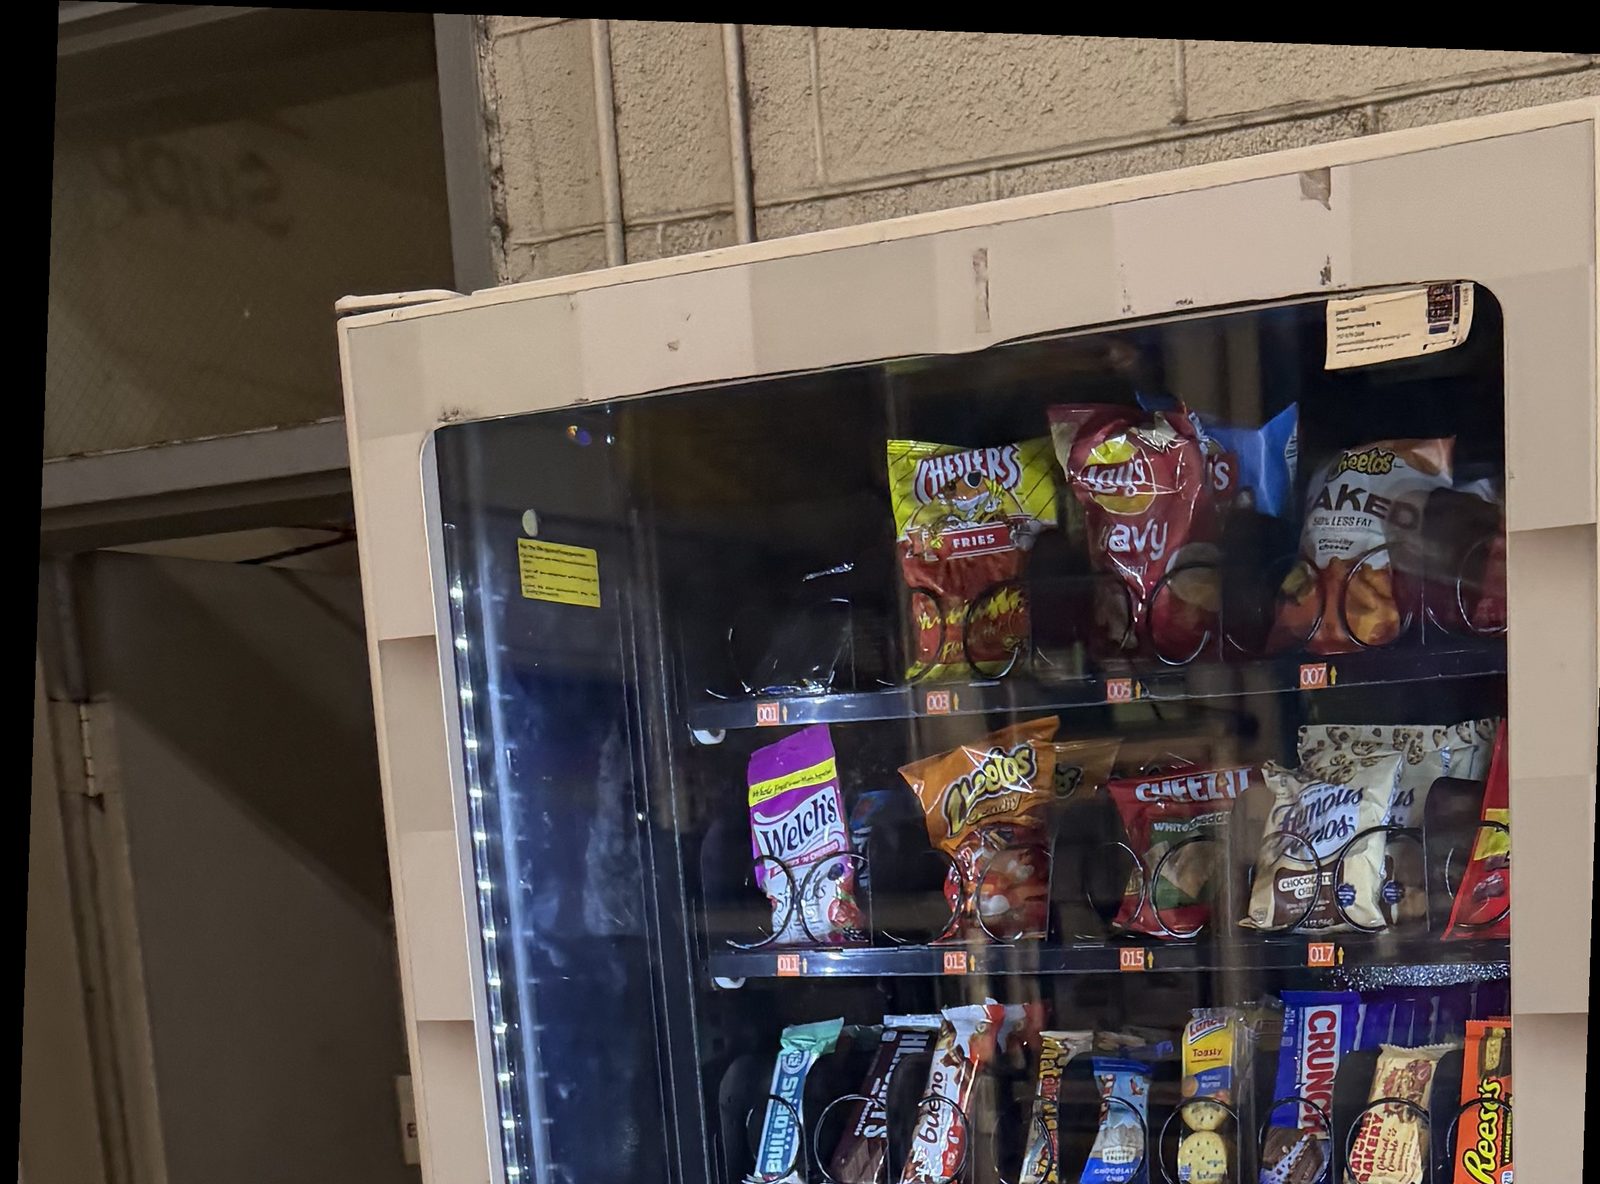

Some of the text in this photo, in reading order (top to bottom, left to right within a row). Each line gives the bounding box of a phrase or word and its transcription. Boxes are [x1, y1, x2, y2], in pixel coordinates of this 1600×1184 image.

[915, 444, 1022, 504] CHESTER'S
[1330, 448, 1395, 481] heetos
[1086, 459, 1146, 498] Lay's
[1312, 484, 1420, 530] AKED
[1331, 516, 1355, 527] LESS
[1356, 518, 1373, 528] FAT
[952, 533, 995, 549] FRIES
[1108, 518, 1168, 561] avy
[1301, 665, 1326, 685] 007
[1108, 680, 1131, 698] 005
[928, 693, 948, 711] 003
[758, 707, 777, 720] 001
[943, 743, 1036, 838] Cheetos
[1276, 788, 1364, 835] Famous
[760, 794, 837, 857] Welch's
[944, 954, 966, 970] 013
[1120, 950, 1144, 967] 015
[1310, 945, 1335, 963] 017
[779, 957, 798, 972] 011
[1192, 1047, 1222, 1057] Toasty
[918, 1070, 944, 1145] bueno
[854, 1100, 875, 1138] hocolate
[1358, 1113, 1386, 1184] BAKERY
[1106, 1174, 1124, 1182] CHIP
